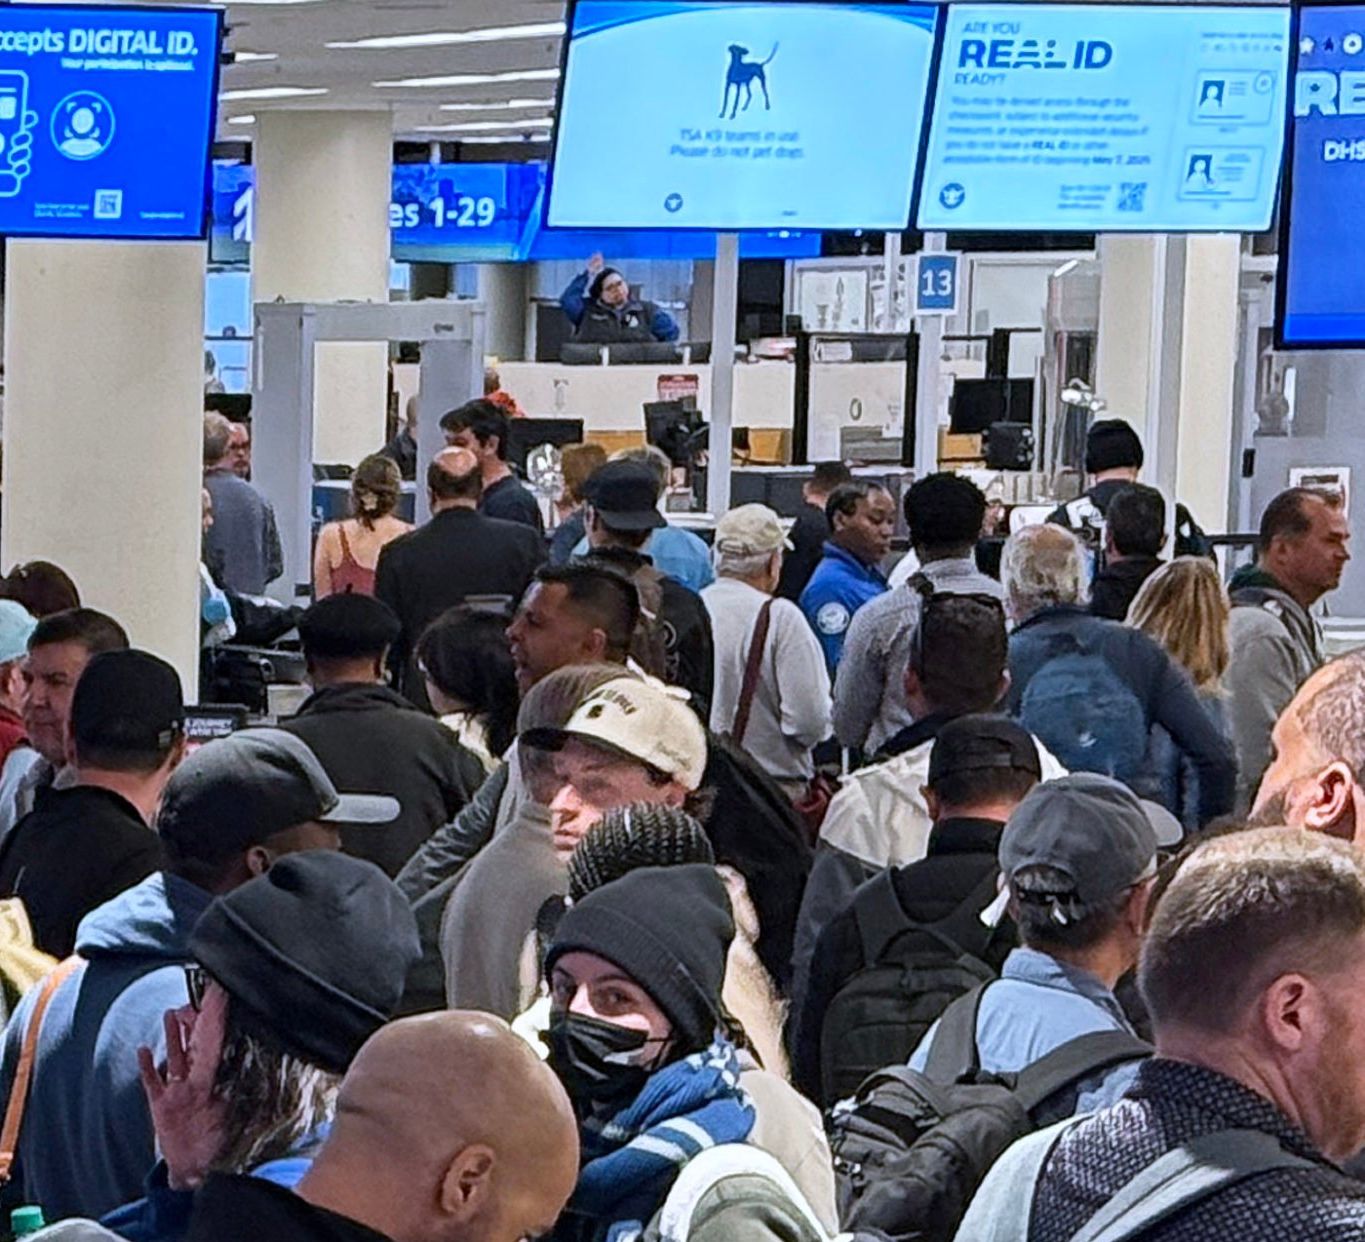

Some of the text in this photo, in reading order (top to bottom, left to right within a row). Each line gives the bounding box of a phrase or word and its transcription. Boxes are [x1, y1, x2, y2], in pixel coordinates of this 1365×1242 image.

[993, 22, 1019, 34] YOU
[69, 29, 163, 55] DIGITAL
[167, 31, 198, 56] ID.
[958, 40, 1113, 69] REAL ID
[429, 196, 495, 228] 1-29
[921, 269, 953, 296] 13
